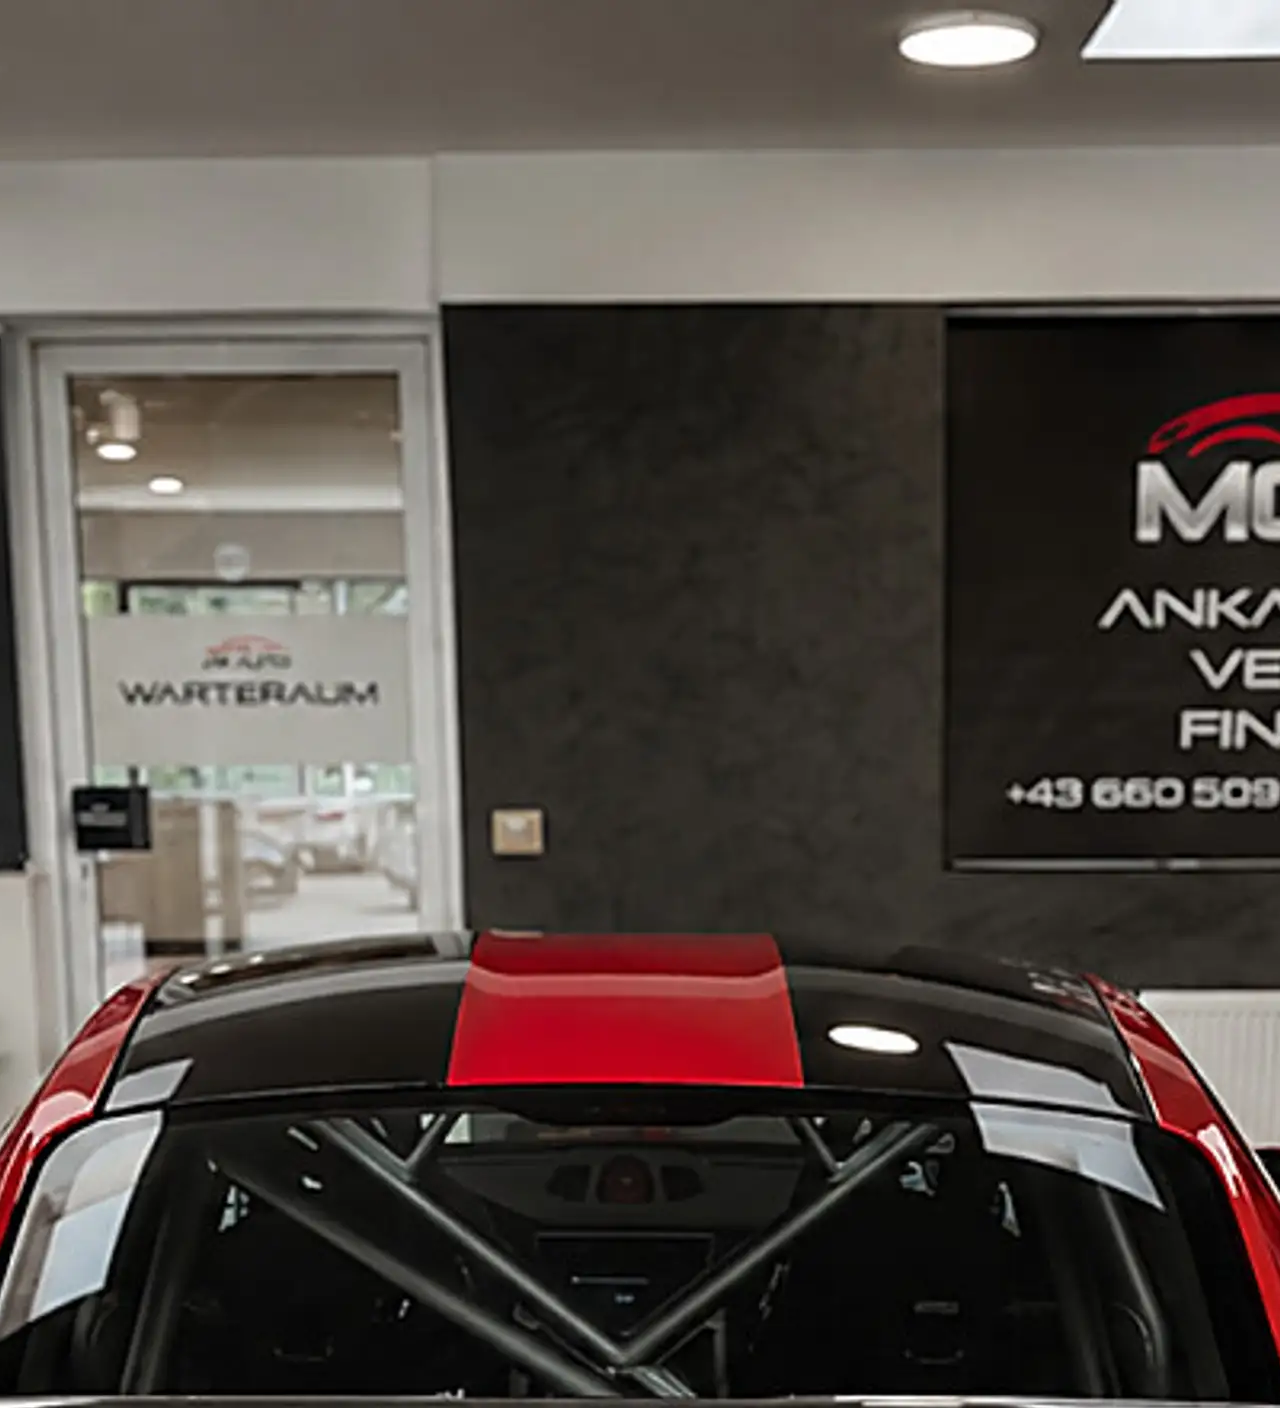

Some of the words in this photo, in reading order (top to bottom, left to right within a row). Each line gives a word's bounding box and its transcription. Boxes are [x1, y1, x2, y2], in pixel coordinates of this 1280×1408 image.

[118, 680, 381, 707] WARTERAUM
[1006, 777, 1084, 809] +43
[1091, 777, 1185, 809] 660
